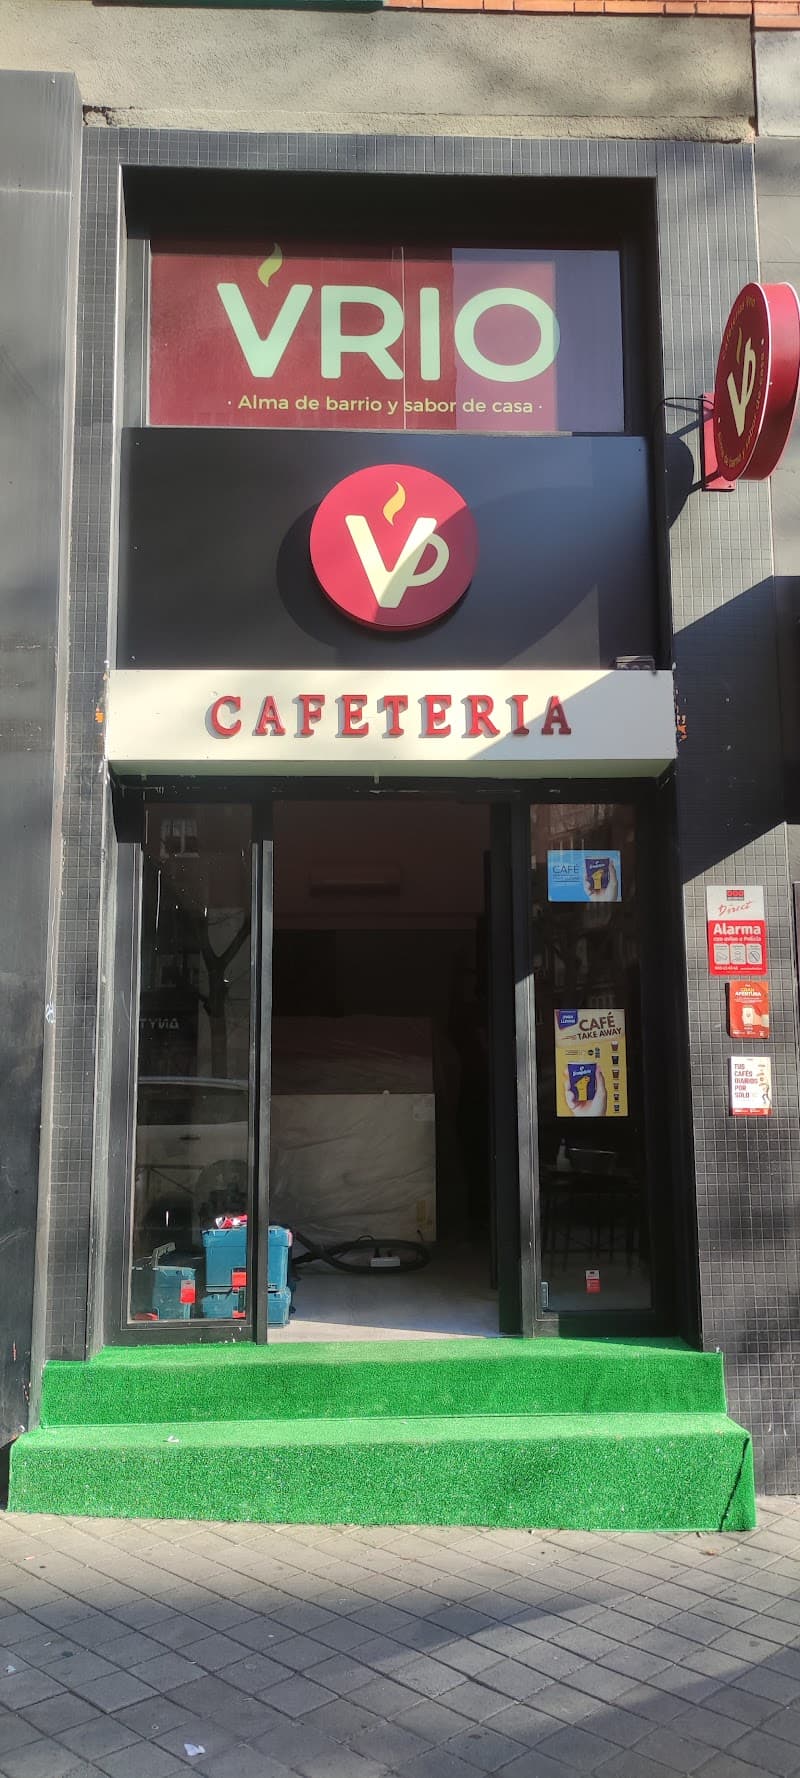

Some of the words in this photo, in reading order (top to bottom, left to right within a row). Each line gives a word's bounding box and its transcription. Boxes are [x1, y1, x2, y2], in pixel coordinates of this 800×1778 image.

[217, 283, 560, 382] VRIO
[238, 395, 289, 411] Alma
[295, 396, 320, 411] de
[326, 396, 382, 412] barrio
[387, 399, 399, 415] y
[404, 398, 457, 413] sabor
[462, 398, 487, 414] de
[492, 401, 534, 414] casa
[210, 694, 572, 737] CAFETERIA
[713, 922, 762, 935] Alarma
[579, 1011, 616, 1031] CAFÉ
[577, 1030, 599, 1040] TAKE
[599, 1027, 622, 1037] AWAY
